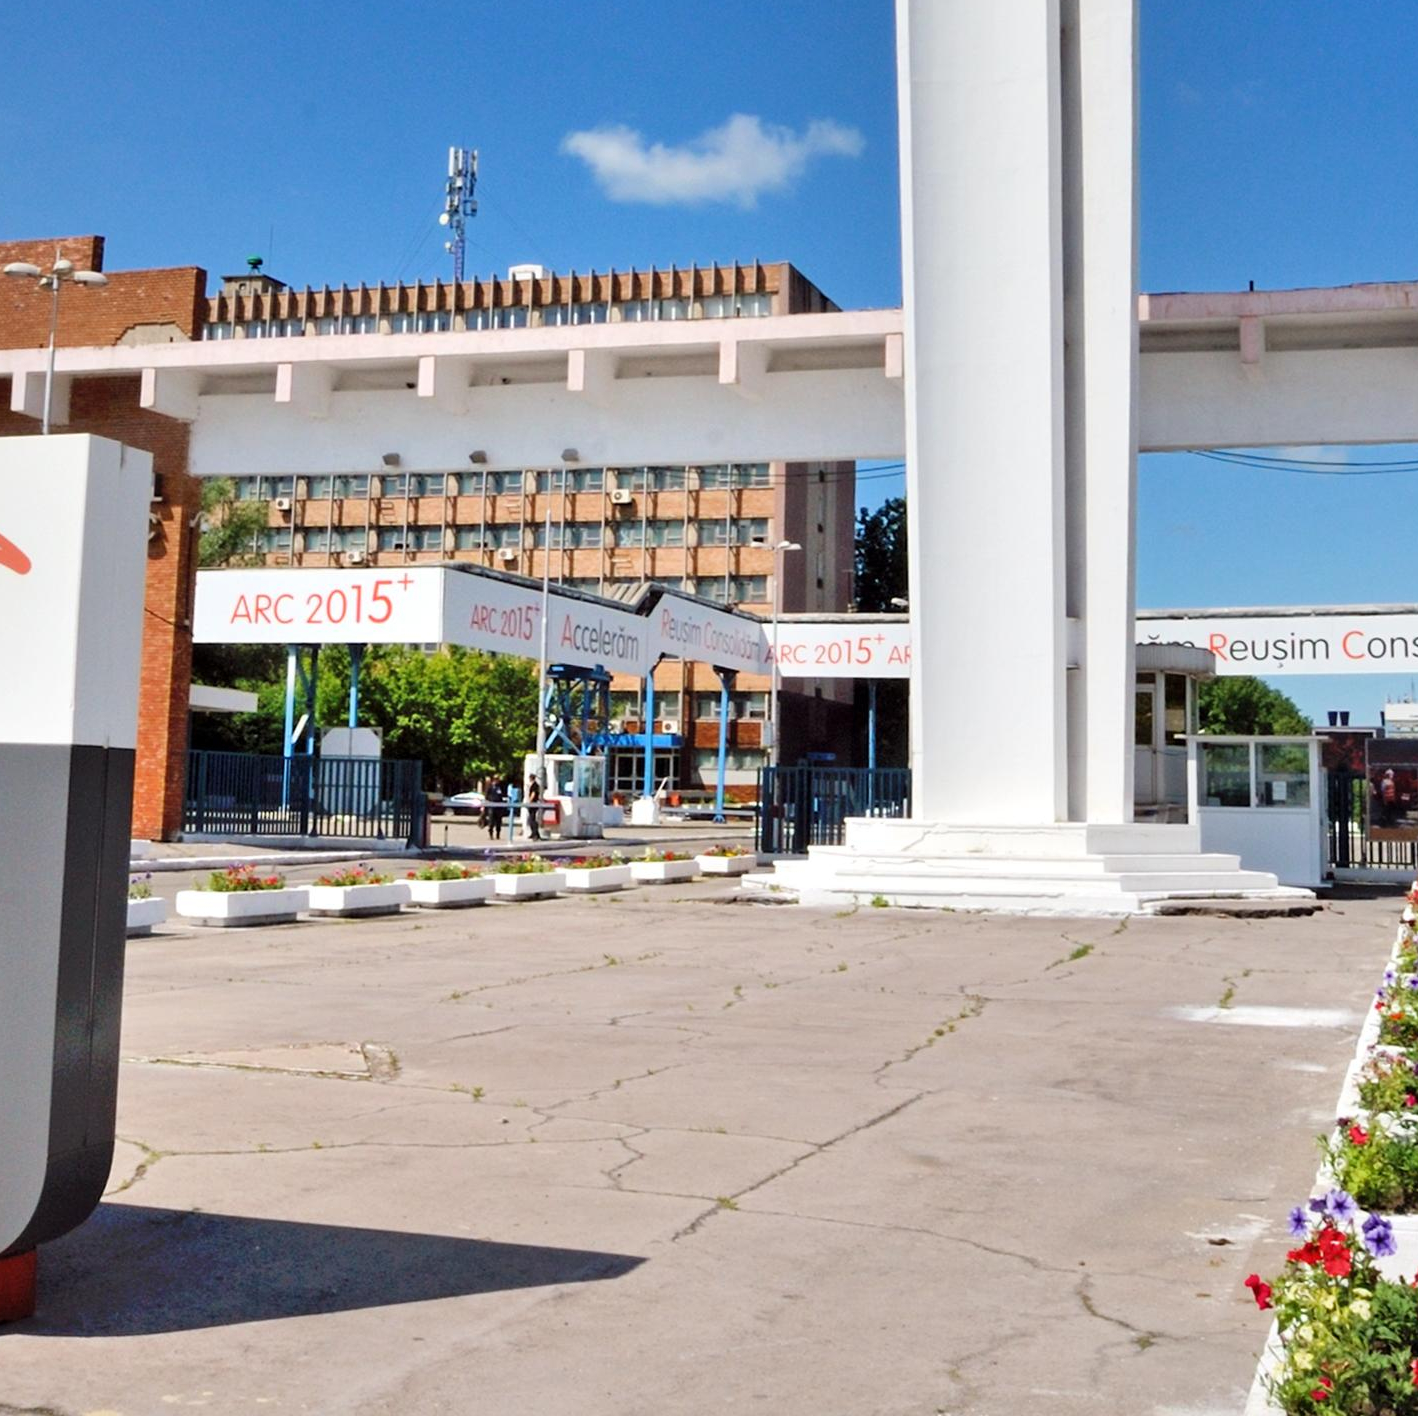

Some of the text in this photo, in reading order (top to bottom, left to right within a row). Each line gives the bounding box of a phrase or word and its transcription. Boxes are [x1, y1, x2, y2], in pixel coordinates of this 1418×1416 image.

[230, 593, 294, 625] ARC
[469, 604, 497, 634] ARC
[560, 613, 640, 662] Accelerăm
[764, 644, 807, 665] ARC
[1208, 632, 1330, 669] Reușim
